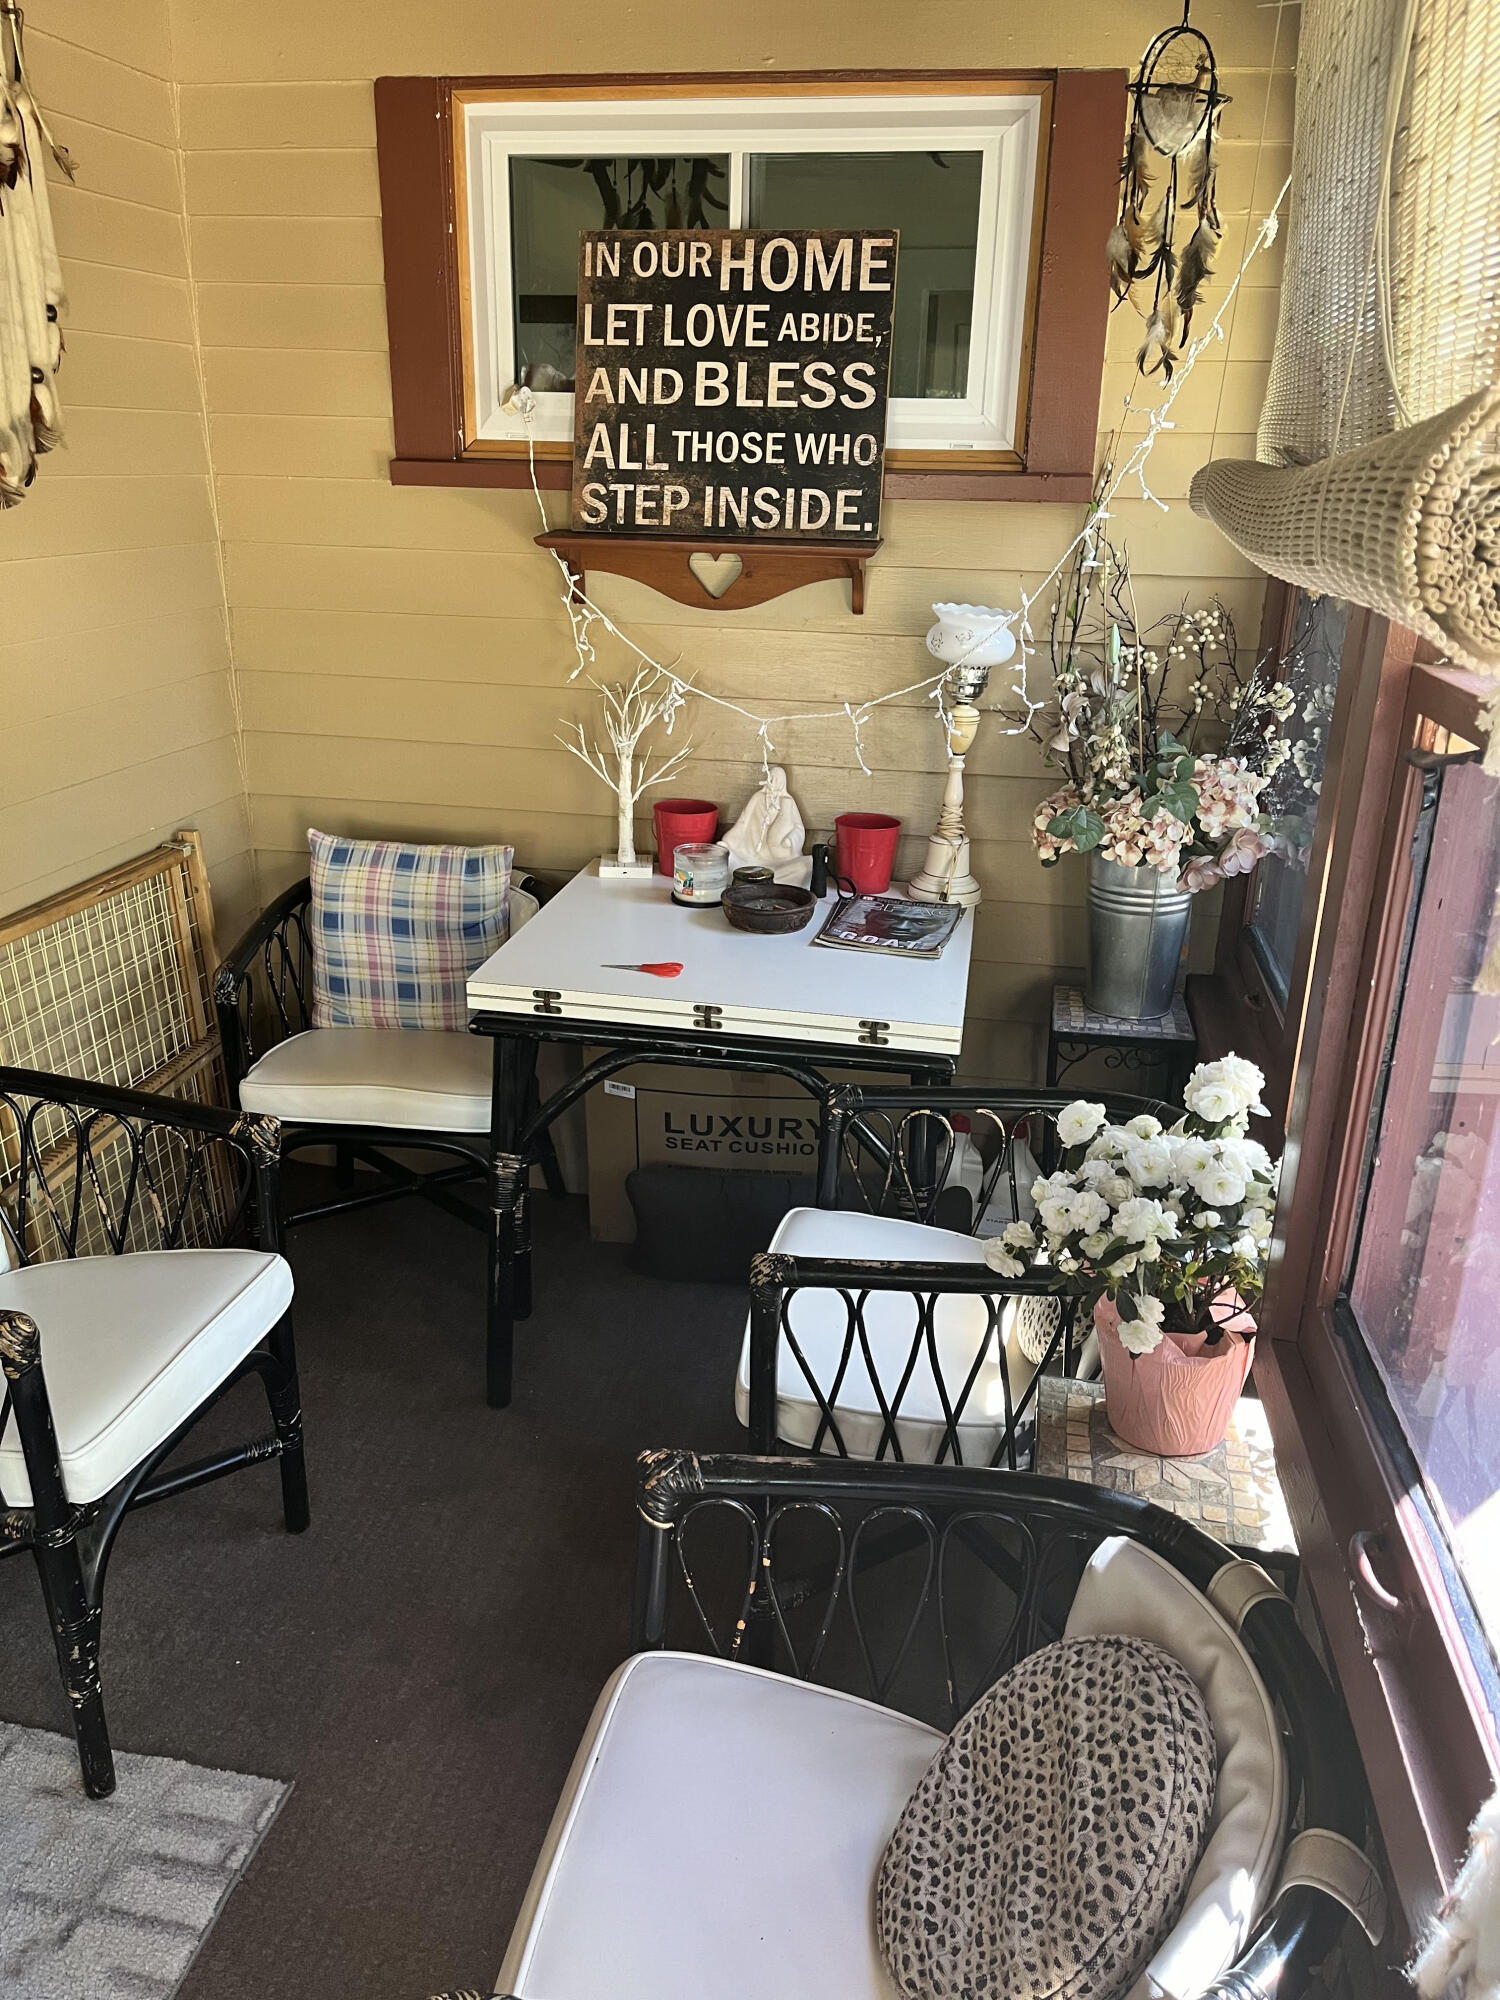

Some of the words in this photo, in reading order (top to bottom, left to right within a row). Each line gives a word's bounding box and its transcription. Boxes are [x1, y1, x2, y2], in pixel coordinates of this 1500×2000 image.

[584, 241, 620, 277] IN
[632, 241, 712, 277] OUR
[719, 237, 894, 292] HOME
[583, 303, 653, 346] LET
[663, 303, 771, 347] LOVE
[777, 312, 882, 348] ABIDE,
[584, 367, 684, 405] AND
[695, 361, 877, 409] BLESS
[583, 422, 669, 470] ALL
[671, 430, 786, 464] THOSE
[794, 433, 878, 466] WHO
[579, 482, 690, 525] STEP
[703, 485, 873, 531] INSIDE.
[664, 1112, 821, 1140] LUXURY
[665, 1137, 723, 1152] SEAT
[729, 1141, 815, 1155] CUSHIO
